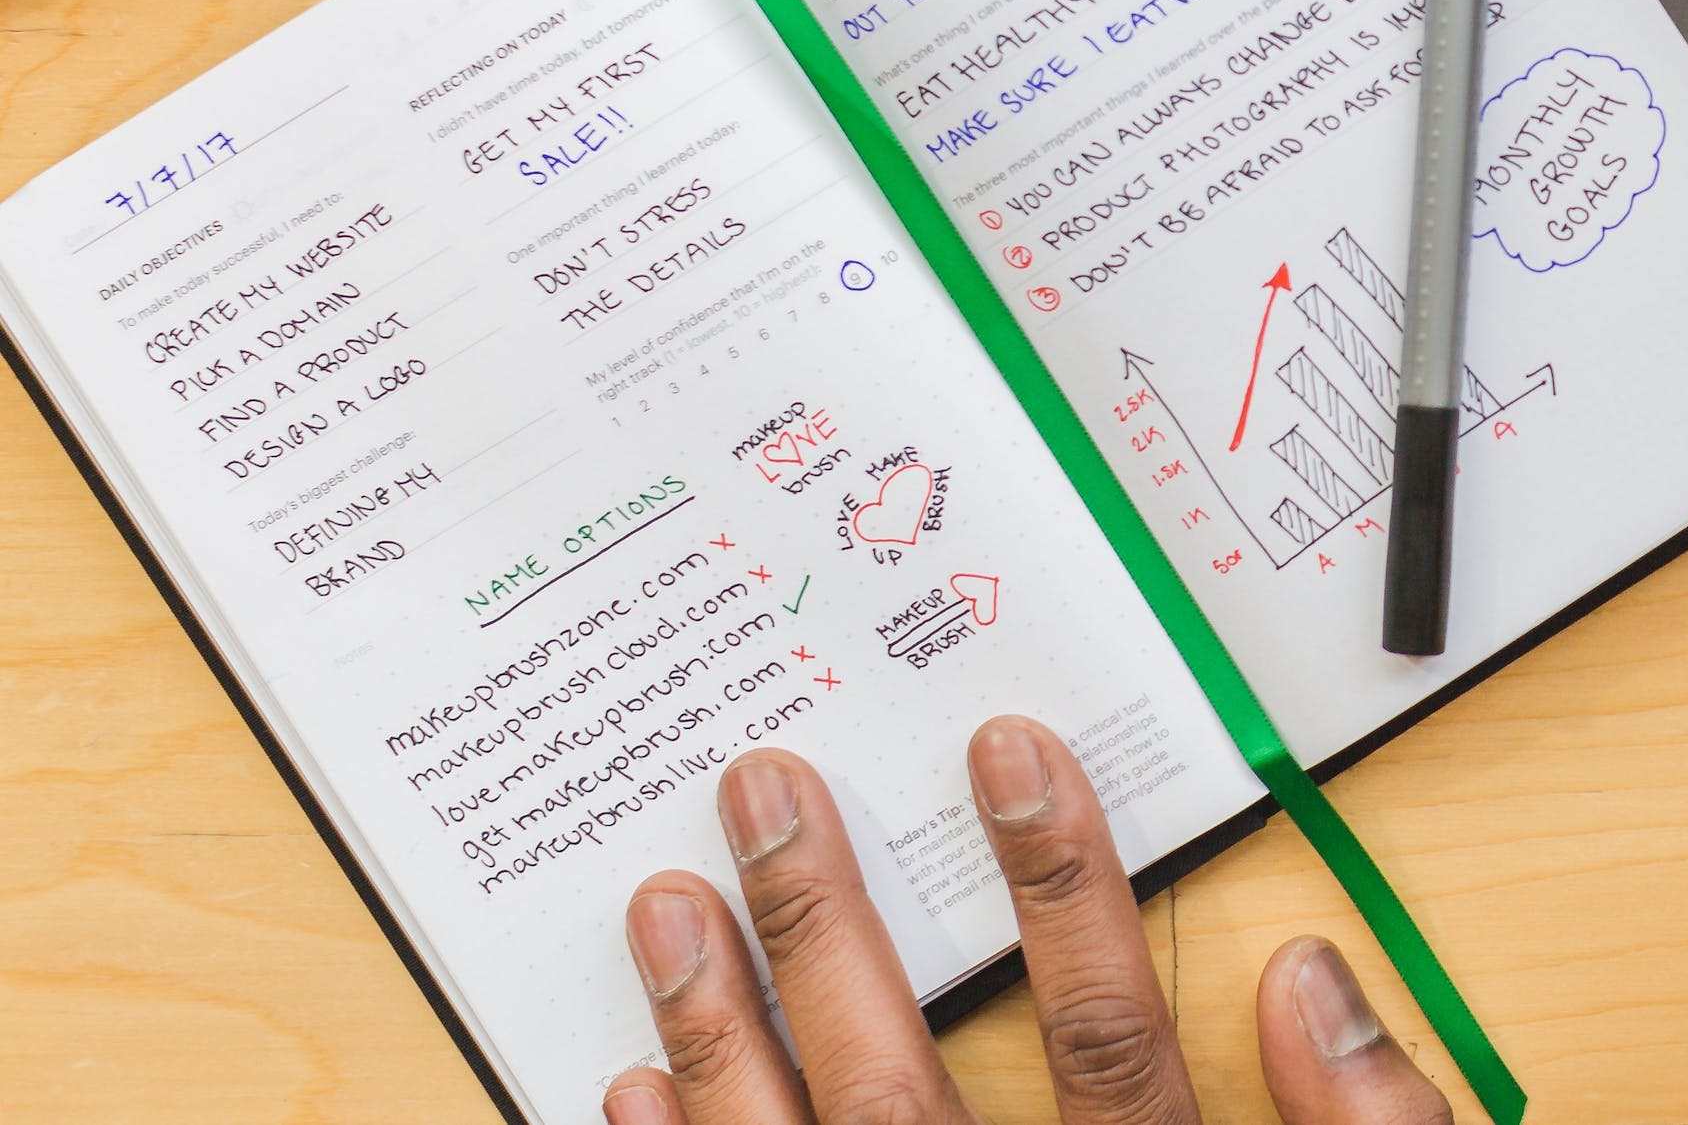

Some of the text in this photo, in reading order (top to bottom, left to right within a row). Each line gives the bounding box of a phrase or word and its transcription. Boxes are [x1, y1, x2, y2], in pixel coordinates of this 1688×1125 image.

[408, 11, 567, 113] REFLECTING ON TODAY
[842, 3, 889, 40] OUT
[436, 109, 476, 139] didn't
[473, 90, 509, 115] have
[506, 71, 540, 95] time
[580, 29, 608, 51] but
[462, 42, 661, 175] GET MY FIRST
[895, 71, 953, 119] EAT
[925, 109, 999, 163] MAKE
[999, 55, 1079, 114] SURE
[1081, 34, 1104, 54] I
[1004, 0, 1332, 216] YOU CAN ALWAYS CHANGE
[518, 105, 634, 186] SALE!!
[1040, 29, 1381, 251] PRODUCT PHOTOGRAPHY IS
[1068, 78, 1392, 294] DON'T BE AFRAID TO ASK
[1528, 93, 1628, 206] GROWTH
[506, 121, 736, 264] One important thing learned today:
[533, 177, 712, 295] DON'T STRESS
[1546, 152, 1628, 242] GOALS
[98, 219, 224, 301] DAILY OBJECTIVES
[116, 316, 137, 330] To
[136, 294, 175, 321] make
[172, 270, 211, 299] today
[289, 199, 325, 227] need
[322, 192, 345, 207] to:
[145, 202, 393, 364] CREATE MY WEBSITE
[559, 216, 746, 330] THE DETAILS
[169, 281, 361, 402] PICK A DOMAIN
[197, 310, 410, 443] FIND A PRODUCT
[222, 358, 427, 479] DESIGN A LOGO
[731, 401, 806, 462] makeup
[864, 445, 919, 482] MAKE
[1493, 420, 1518, 440] A
[246, 431, 414, 533] Today's biggest challenge:
[272, 461, 442, 564] DEFINING MY
[780, 447, 852, 495] brush
[463, 474, 686, 616] NAME OPTIONS
[1317, 552, 1336, 575] A
[1354, 517, 1386, 538] M
[874, 587, 947, 641] MAKEUP
[905, 621, 977, 670] BRUSH
[884, 803, 966, 853] Today's Tip:
